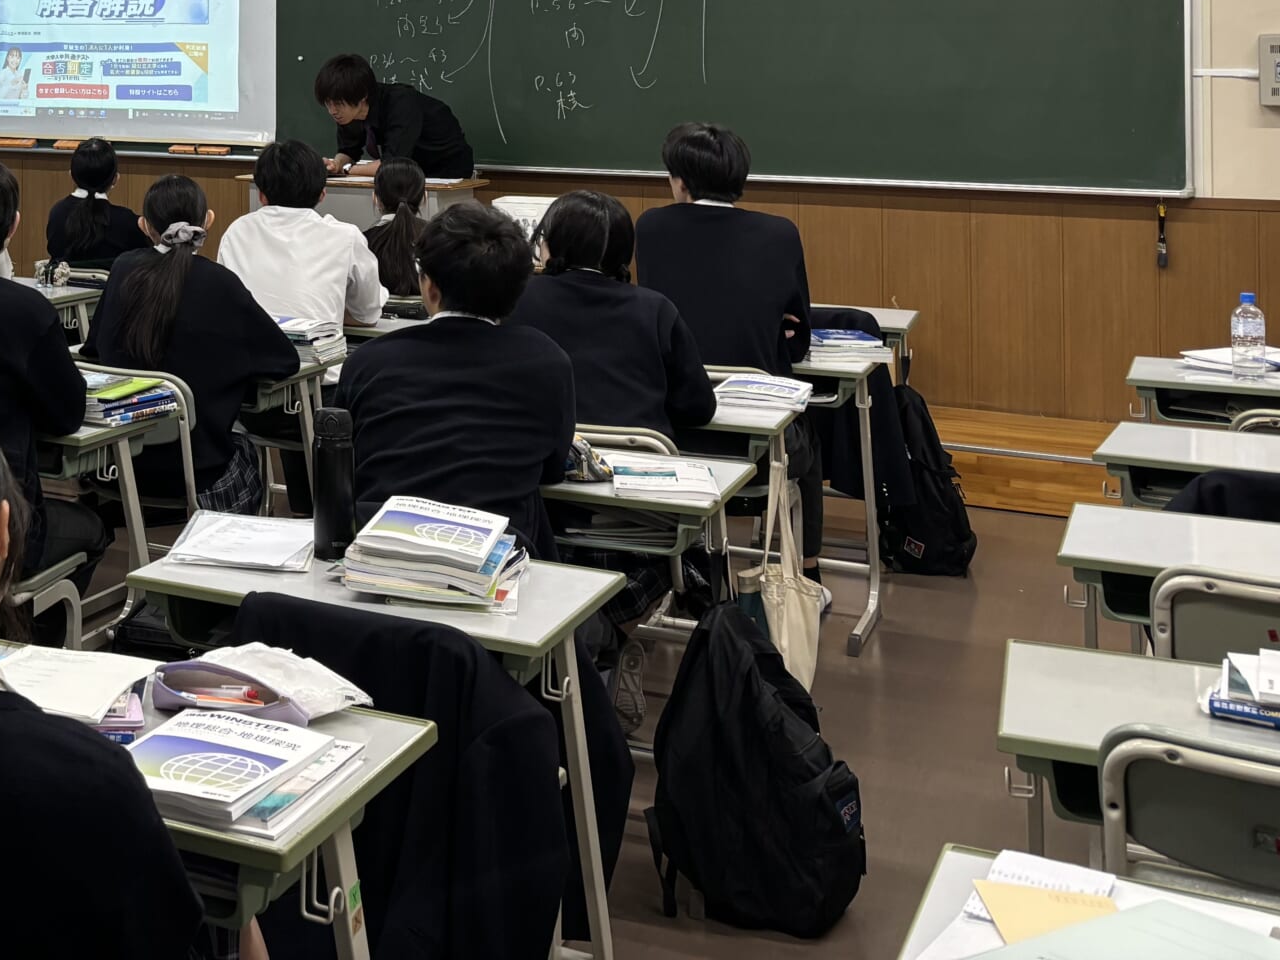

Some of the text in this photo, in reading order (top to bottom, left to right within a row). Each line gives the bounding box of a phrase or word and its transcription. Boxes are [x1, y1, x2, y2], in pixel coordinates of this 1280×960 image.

[42, 61, 92, 76] 合否判定
[209, 713, 289, 732] WINSTEP
